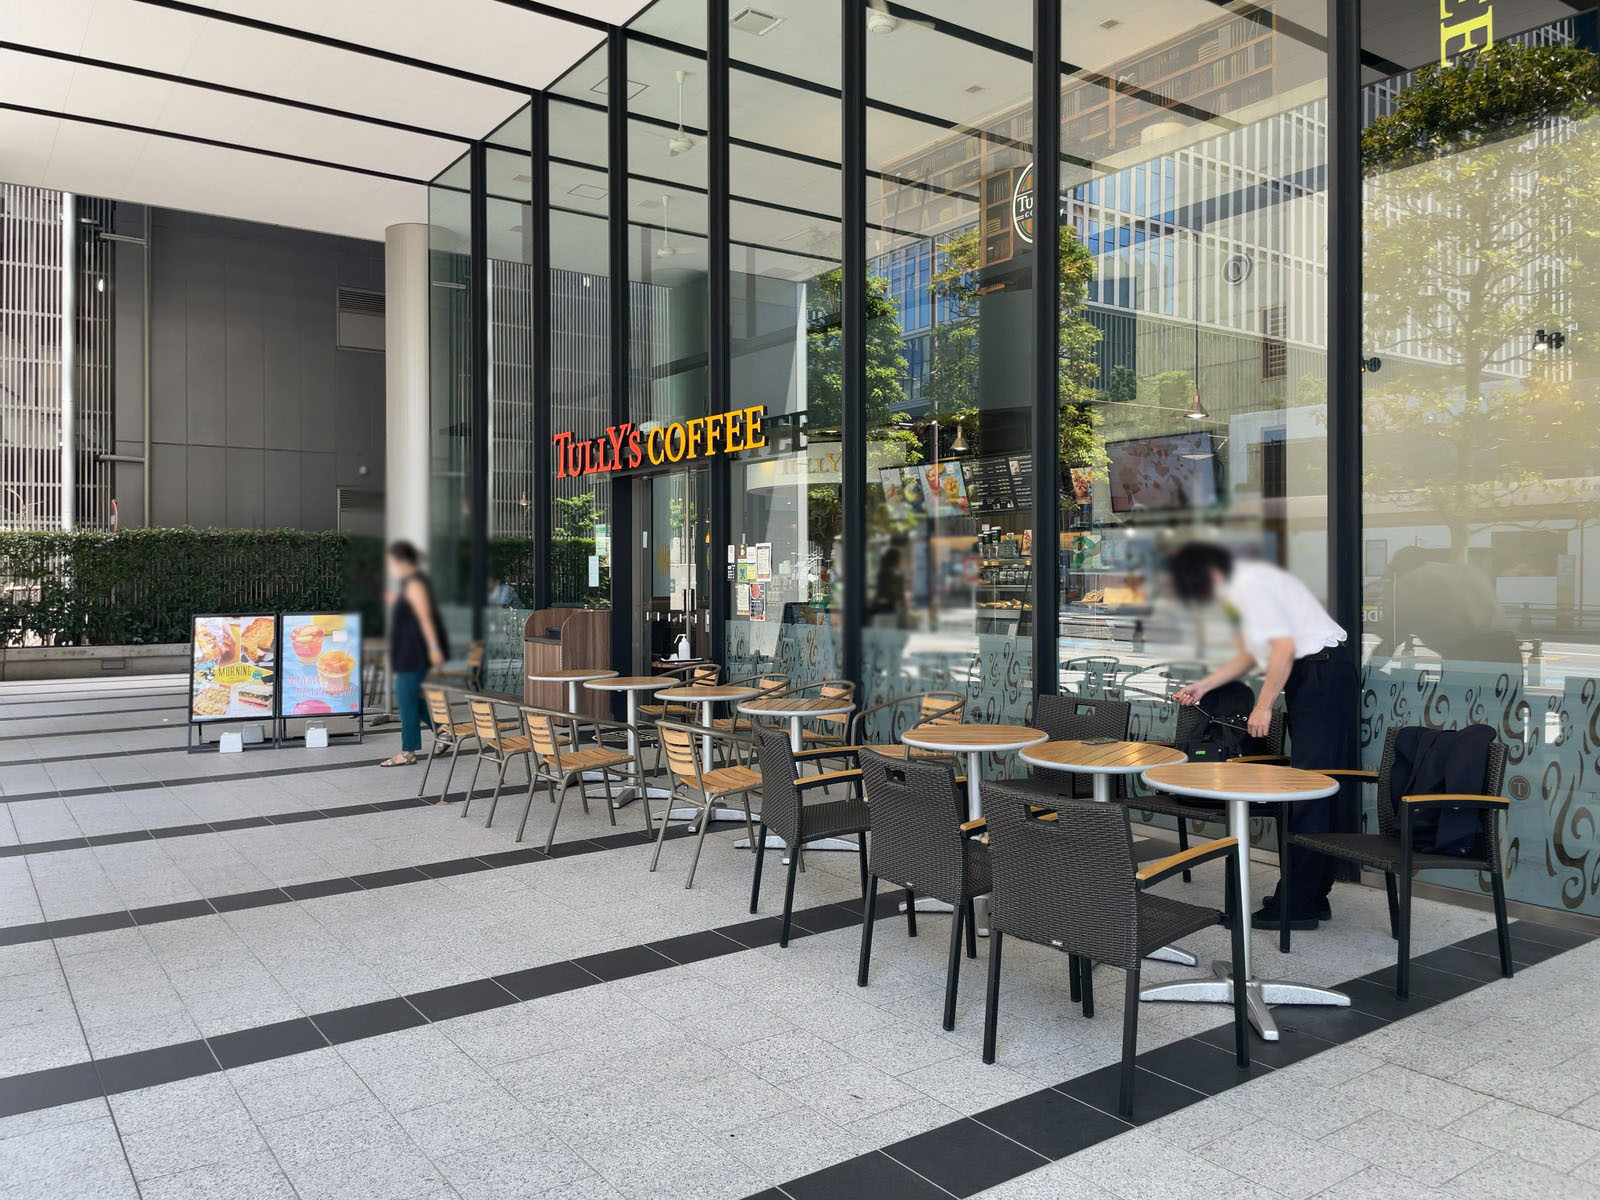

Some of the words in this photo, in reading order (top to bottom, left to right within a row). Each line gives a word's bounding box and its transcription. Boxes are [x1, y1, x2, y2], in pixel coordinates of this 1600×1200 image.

[553, 423, 642, 478] TULLY'S
[648, 405, 766, 465] COFFEE
[218, 665, 252, 677] MORNING
